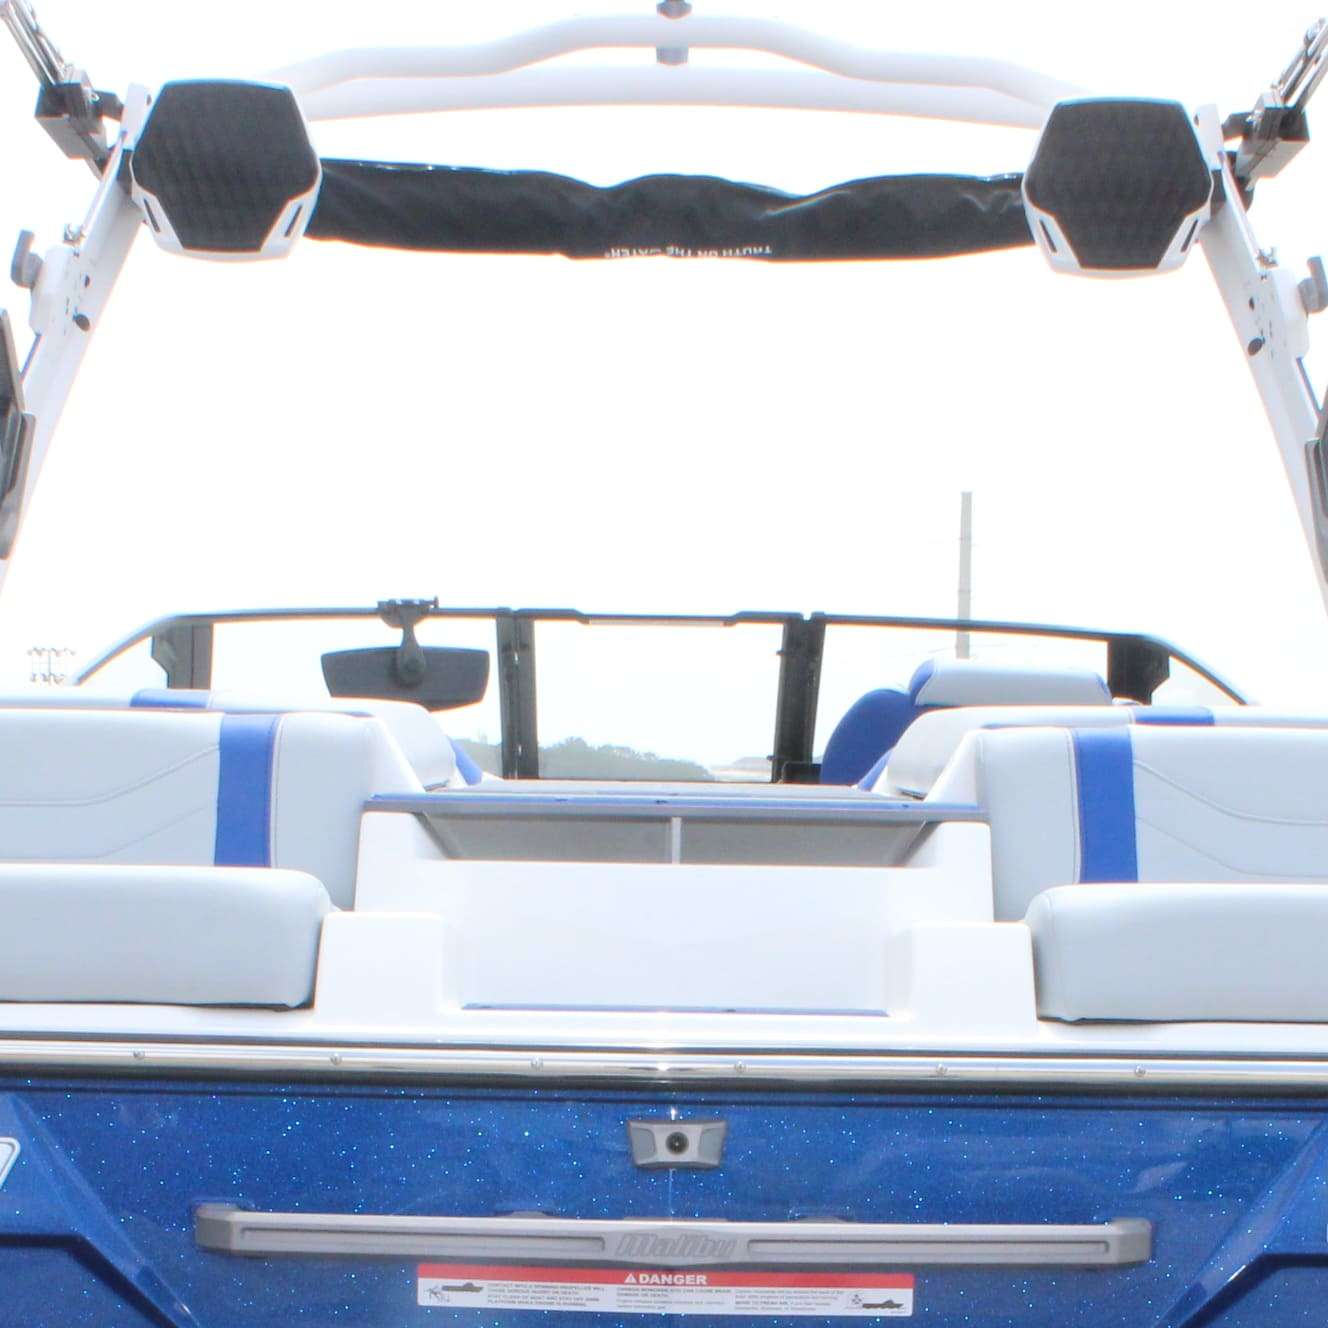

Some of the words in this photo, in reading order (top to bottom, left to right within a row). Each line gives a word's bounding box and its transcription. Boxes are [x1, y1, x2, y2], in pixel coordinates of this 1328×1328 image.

[664, 246, 692, 258] THE
[722, 245, 771, 258] TRUTH
[638, 1273, 707, 1286] DANGER
